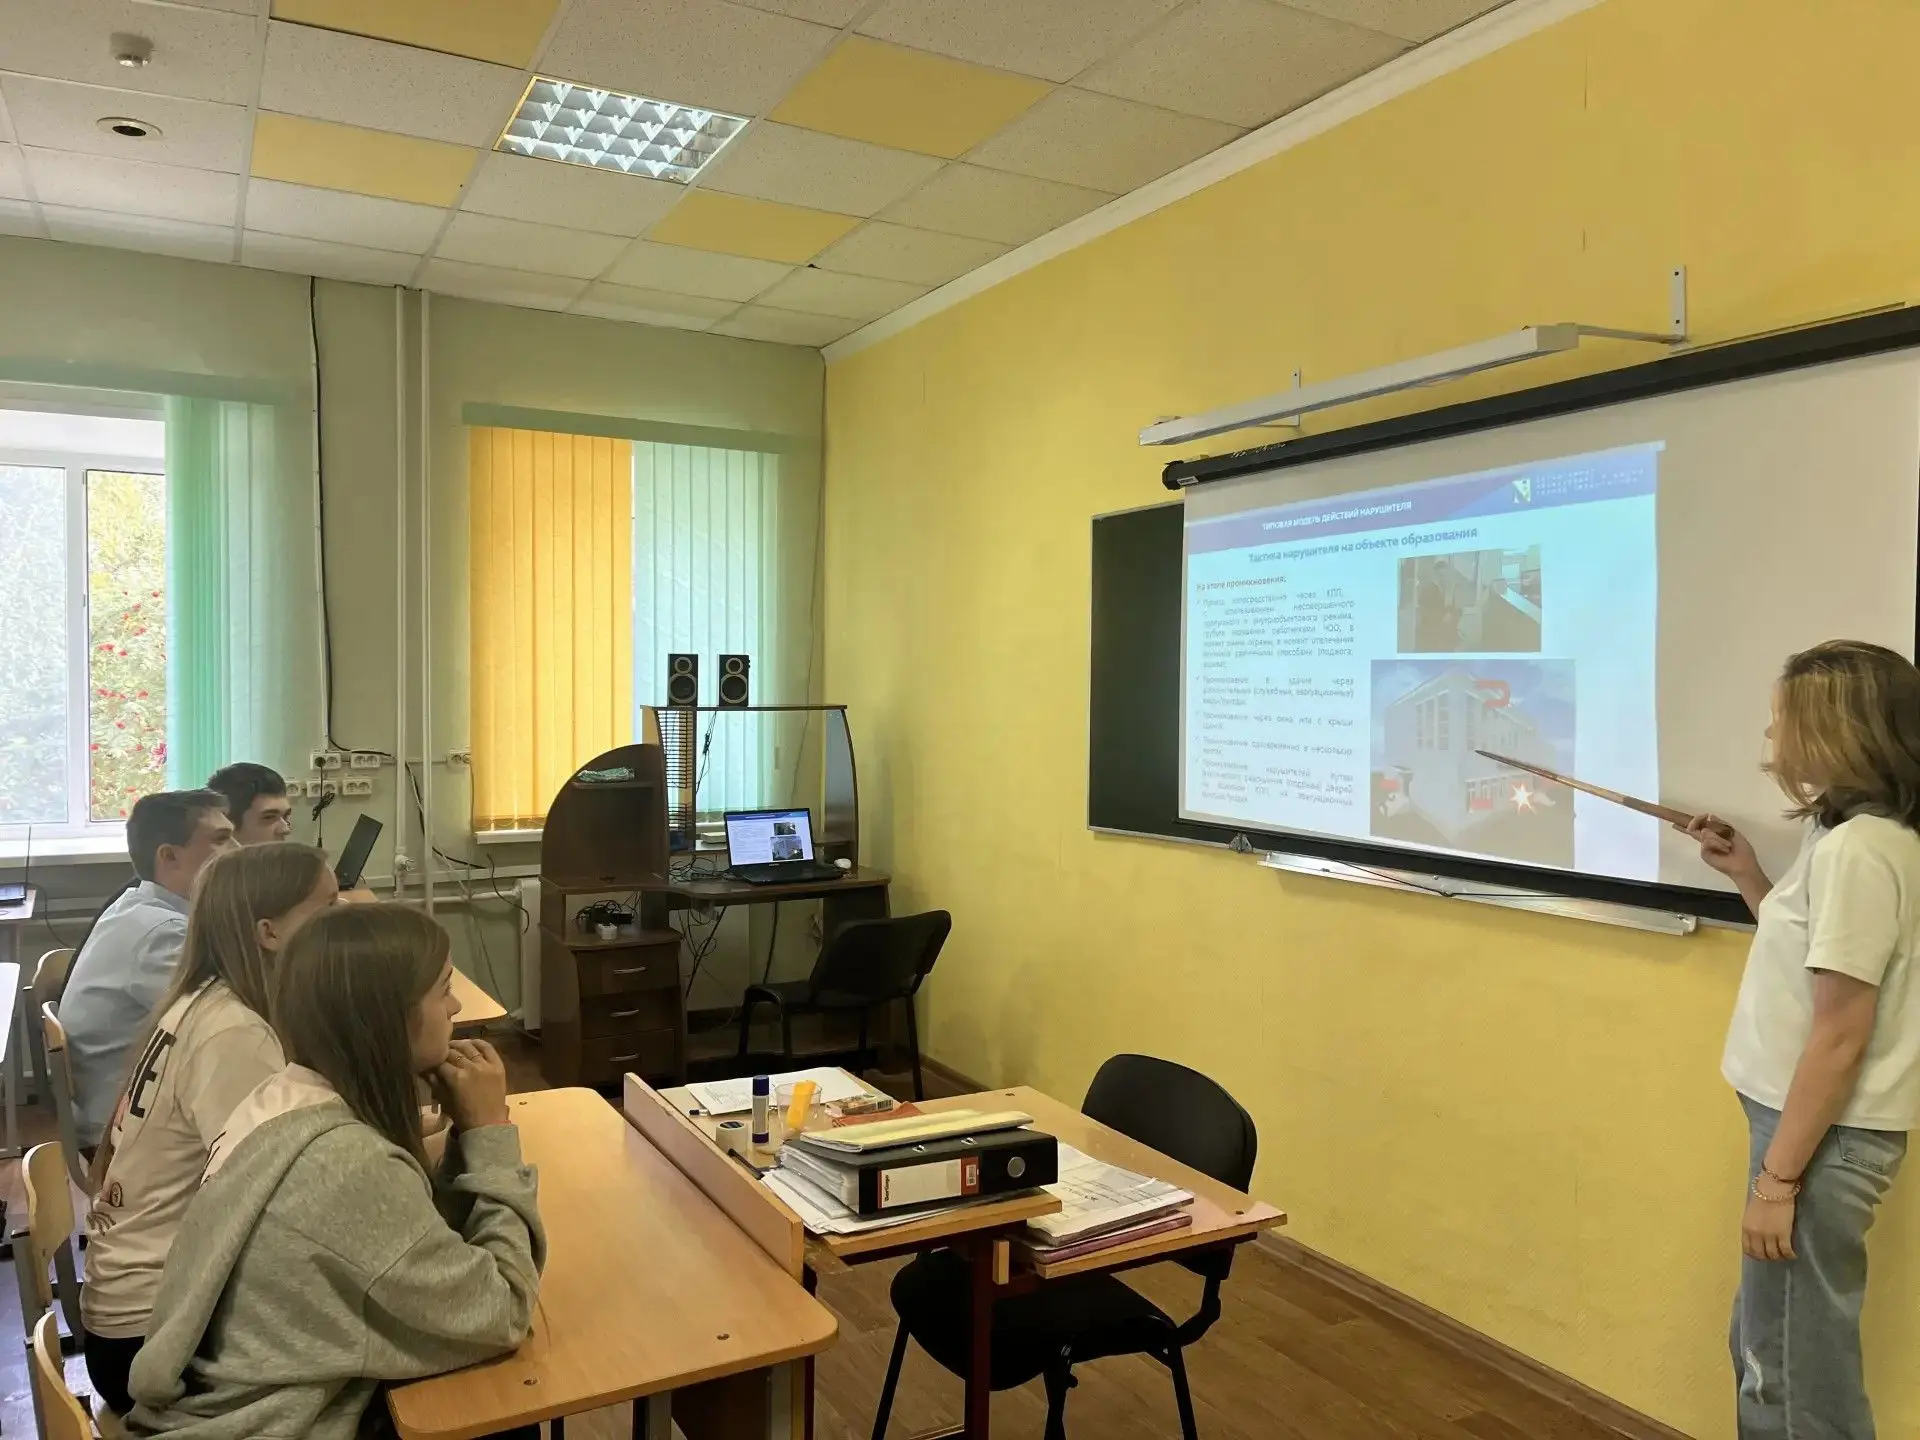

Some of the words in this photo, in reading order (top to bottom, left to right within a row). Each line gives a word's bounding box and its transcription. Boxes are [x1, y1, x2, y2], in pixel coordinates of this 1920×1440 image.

[1293, 516, 1321, 526] МОДЕЛЬ
[1321, 509, 1359, 523] ДЕЙСТВИЙ
[1359, 501, 1412, 515] НАРУШИТЕЛЯ
[1249, 553, 1282, 563] Тактика
[1282, 545, 1339, 560] нарушителя
[1341, 543, 1353, 552] на
[1355, 537, 1399, 550] объекте
[1401, 528, 1478, 548] образования
[1226, 576, 1287, 588] проникновения:
[1332, 677, 1354, 687] через
